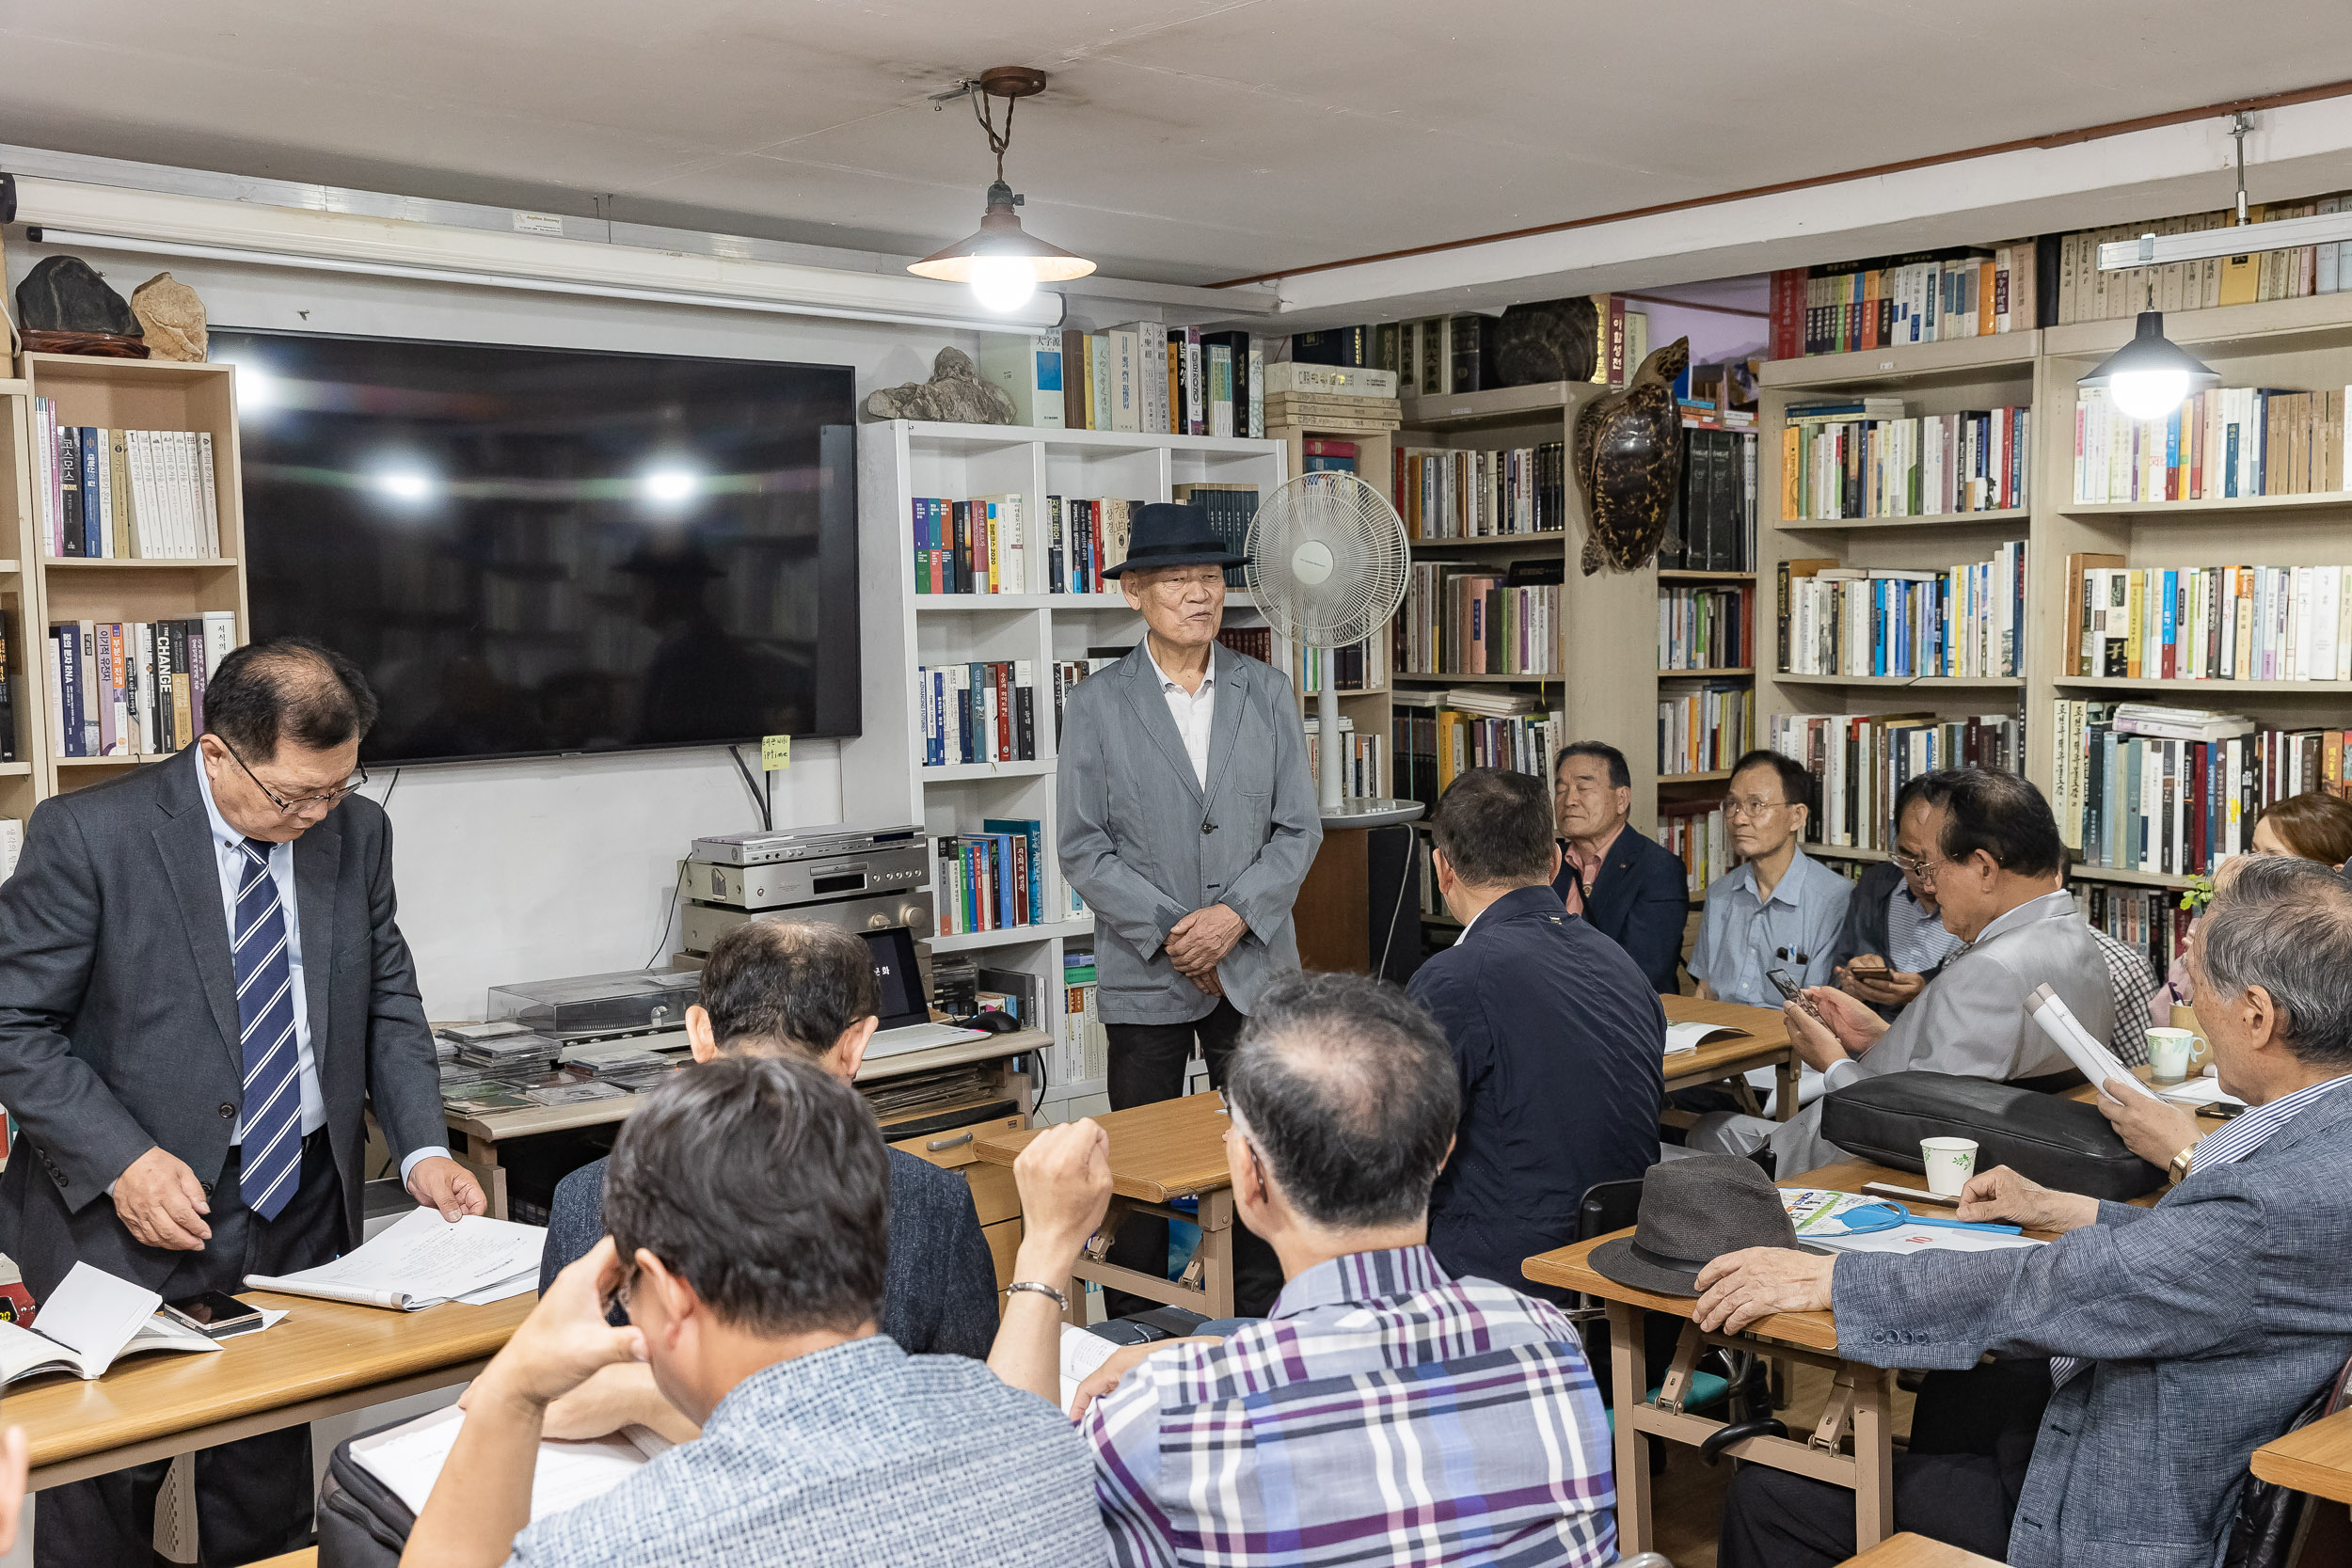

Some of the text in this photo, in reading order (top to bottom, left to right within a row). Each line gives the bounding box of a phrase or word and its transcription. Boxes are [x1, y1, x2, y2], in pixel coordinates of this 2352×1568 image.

[62, 438, 74, 481] 코스모스
[99, 630, 111, 681] 이기적 유전자
[158, 637, 172, 692] CHANGE
[65, 665, 73, 683] RNA
[764, 749, 787, 760] iptime
[1906, 1236, 1933, 1244] 10
